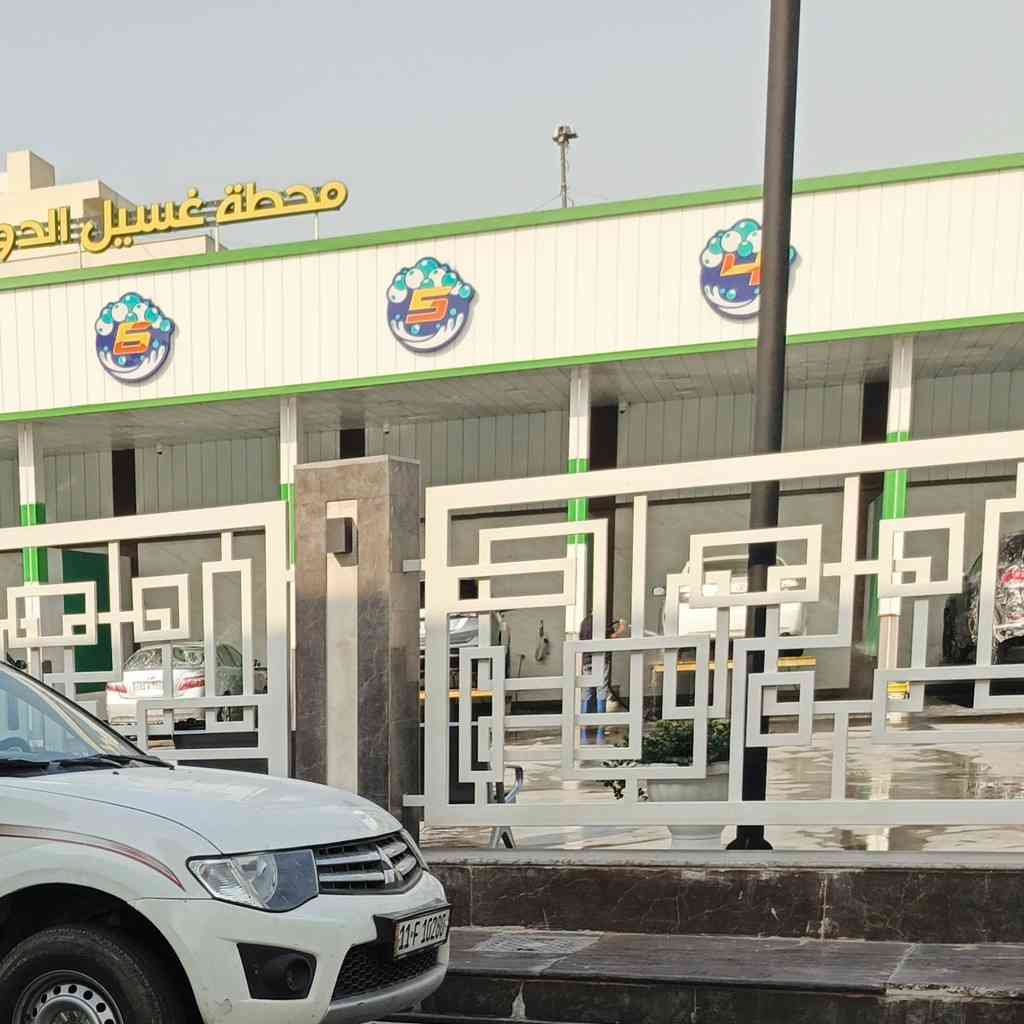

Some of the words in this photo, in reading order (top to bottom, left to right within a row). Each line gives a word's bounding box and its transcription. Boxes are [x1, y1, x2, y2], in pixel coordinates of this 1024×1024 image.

[81, 186, 205, 254] غسيل
[216, 179, 349, 226] محطة
[719, 251, 763, 287] 4
[405, 286, 452, 325] 5
[113, 321, 153, 356] 6
